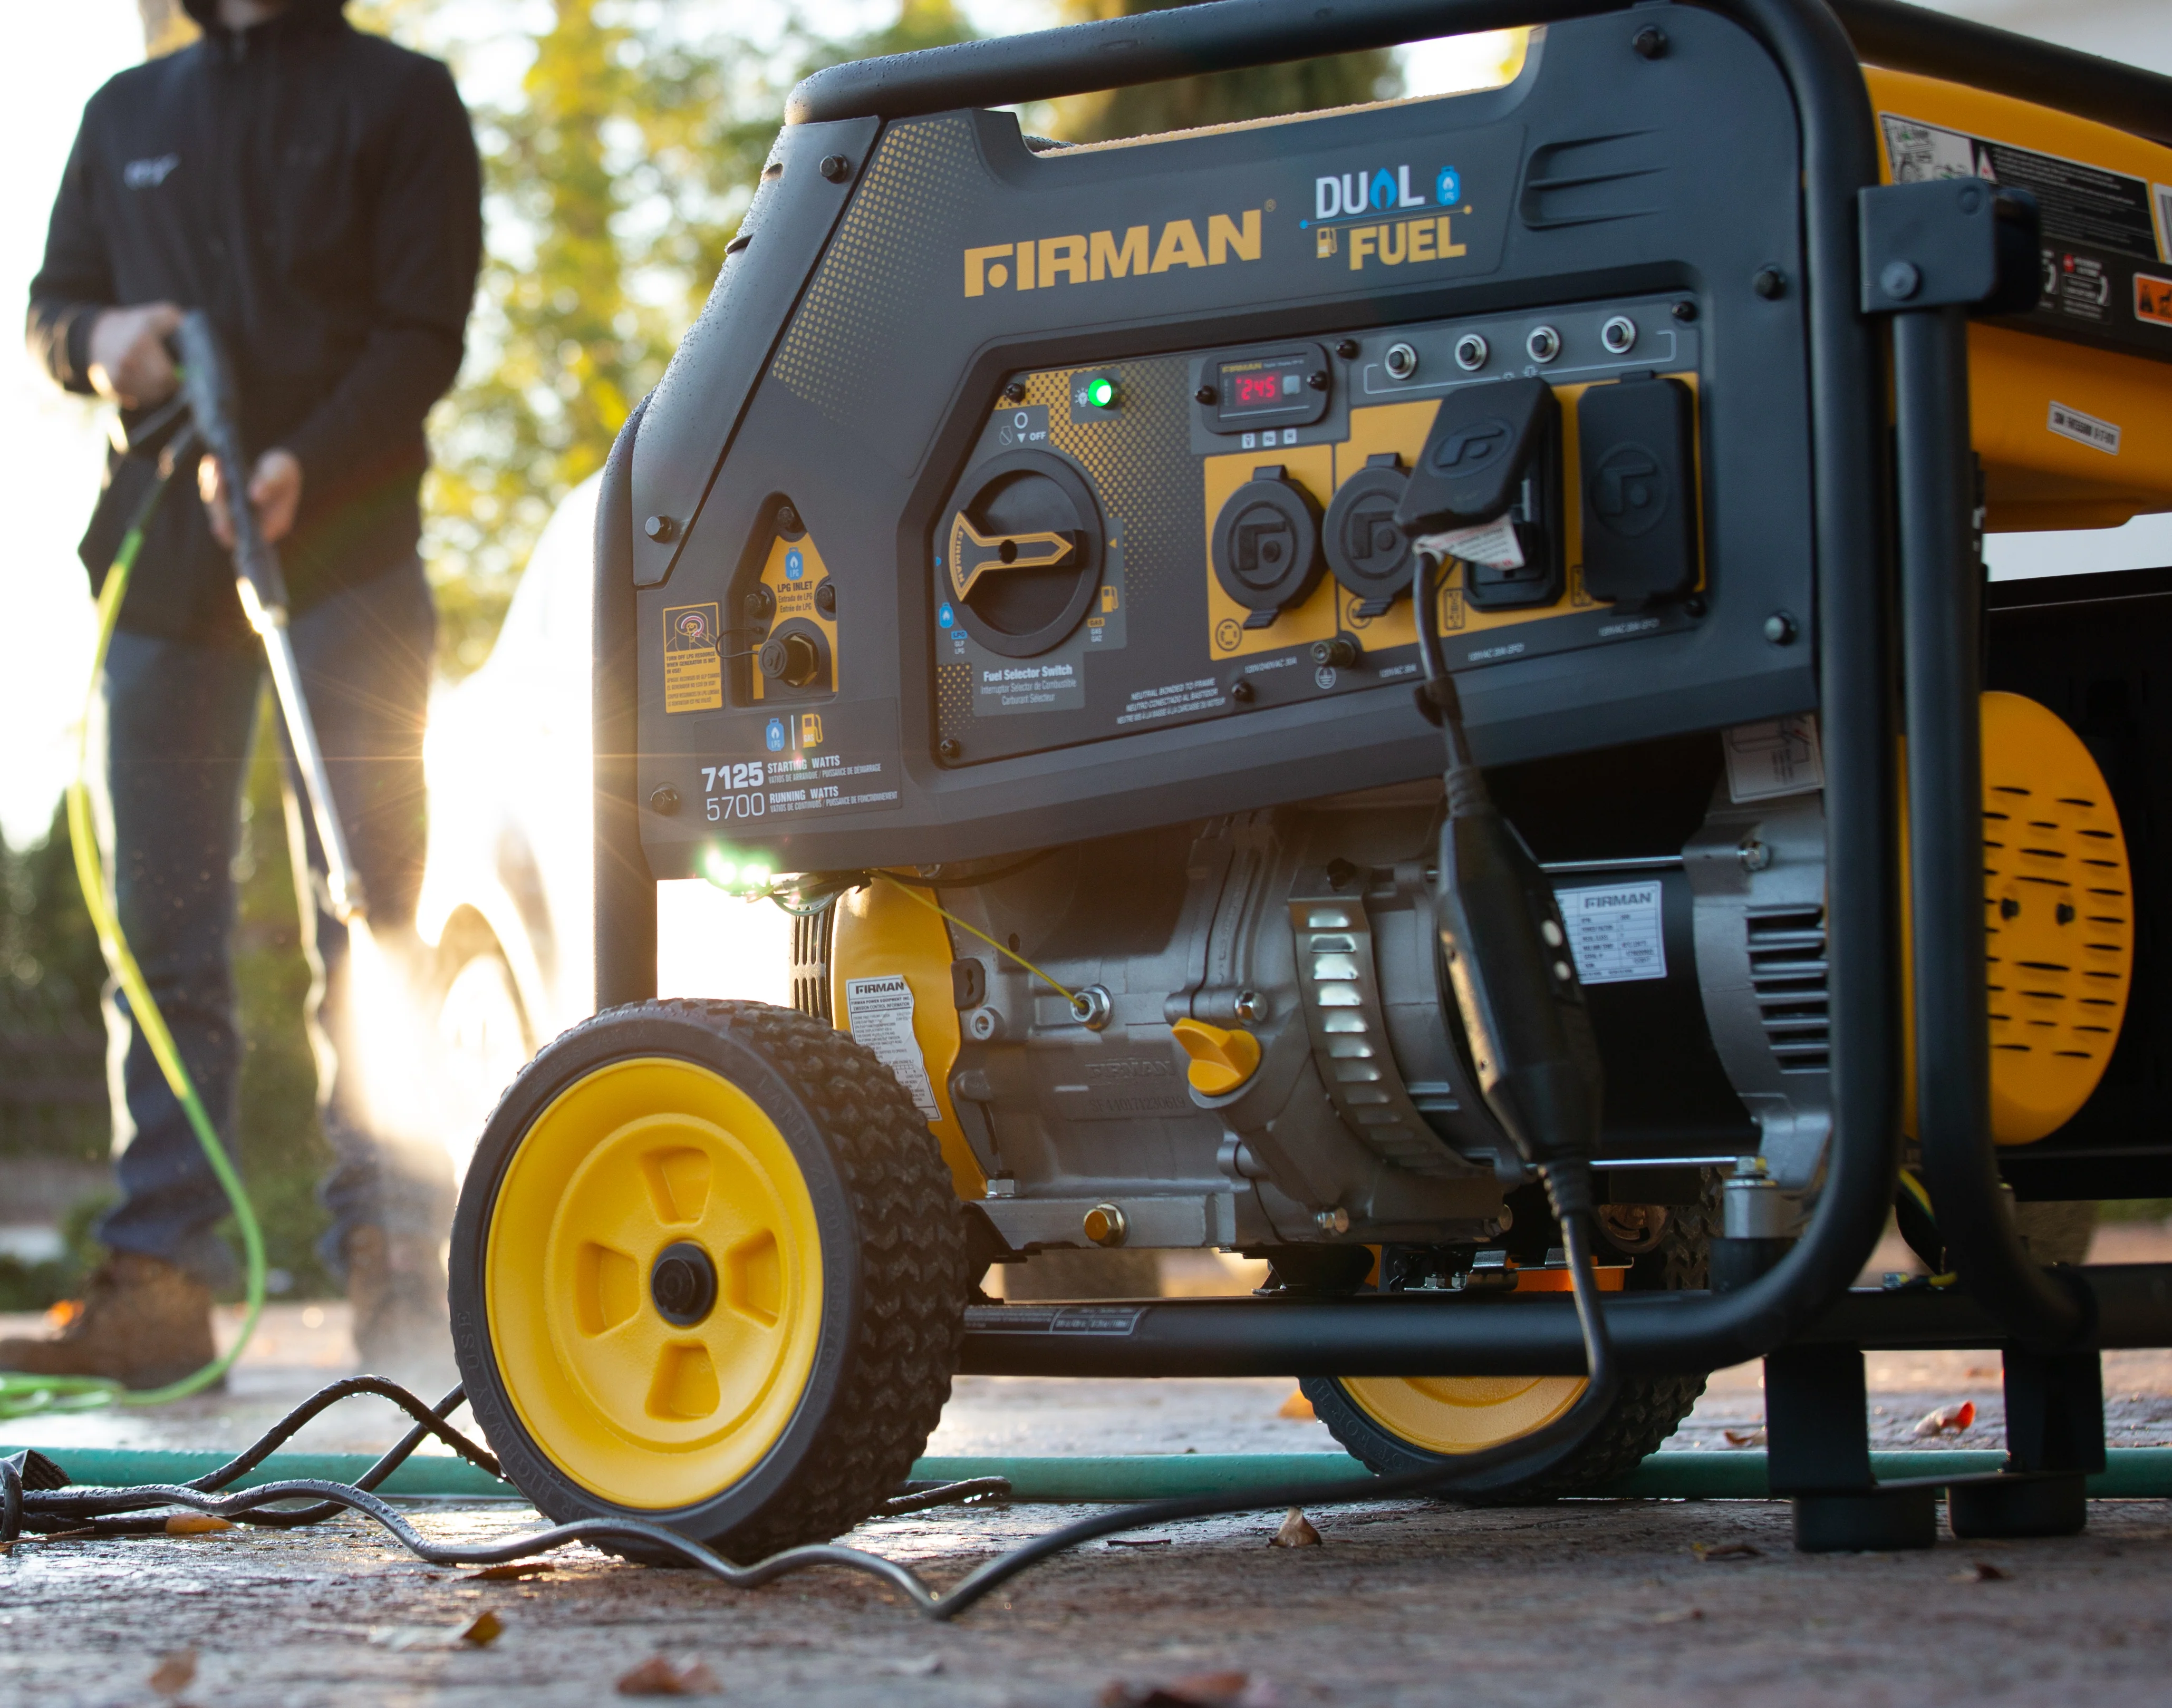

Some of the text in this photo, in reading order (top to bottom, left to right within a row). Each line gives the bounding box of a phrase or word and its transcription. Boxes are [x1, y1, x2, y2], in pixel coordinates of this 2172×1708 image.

[1316, 165, 1425, 219] DUAL
[1349, 216, 1466, 270] FUEL
[964, 209, 1262, 297] FIRMAN
[1241, 376, 1275, 400] 245
[1029, 431, 1046, 441] OFF
[955, 530, 966, 583] FIRMAN
[789, 569, 799, 578] LPG
[777, 581, 813, 593] LPG INLET
[803, 603, 812, 611] LPG
[983, 664, 1073, 683] Fuel Selector Switch
[1033, 681, 1041, 691] de
[1041, 678, 1077, 691] Combustible
[1131, 677, 1216, 701] NEUTRAL BONDED TO FRAME
[771, 734, 814, 749] LPG GAS
[701, 754, 840, 792] 7125 STARTING WATTS
[785, 773, 792, 782] DE
[793, 771, 818, 781] ARRANQUE
[846, 766, 854, 775] DE
[706, 785, 839, 821] 5700 RUNNING WATTS
[787, 802, 794, 812] DE
[826, 797, 850, 807] PUISSANCE
[850, 795, 857, 804] DE
[1584, 892, 1652, 909] FIRMAN
[855, 982, 904, 994] FIRMAN
[457, 1309, 483, 1373] USE
[472, 1379, 555, 1503] HIGHWAY
